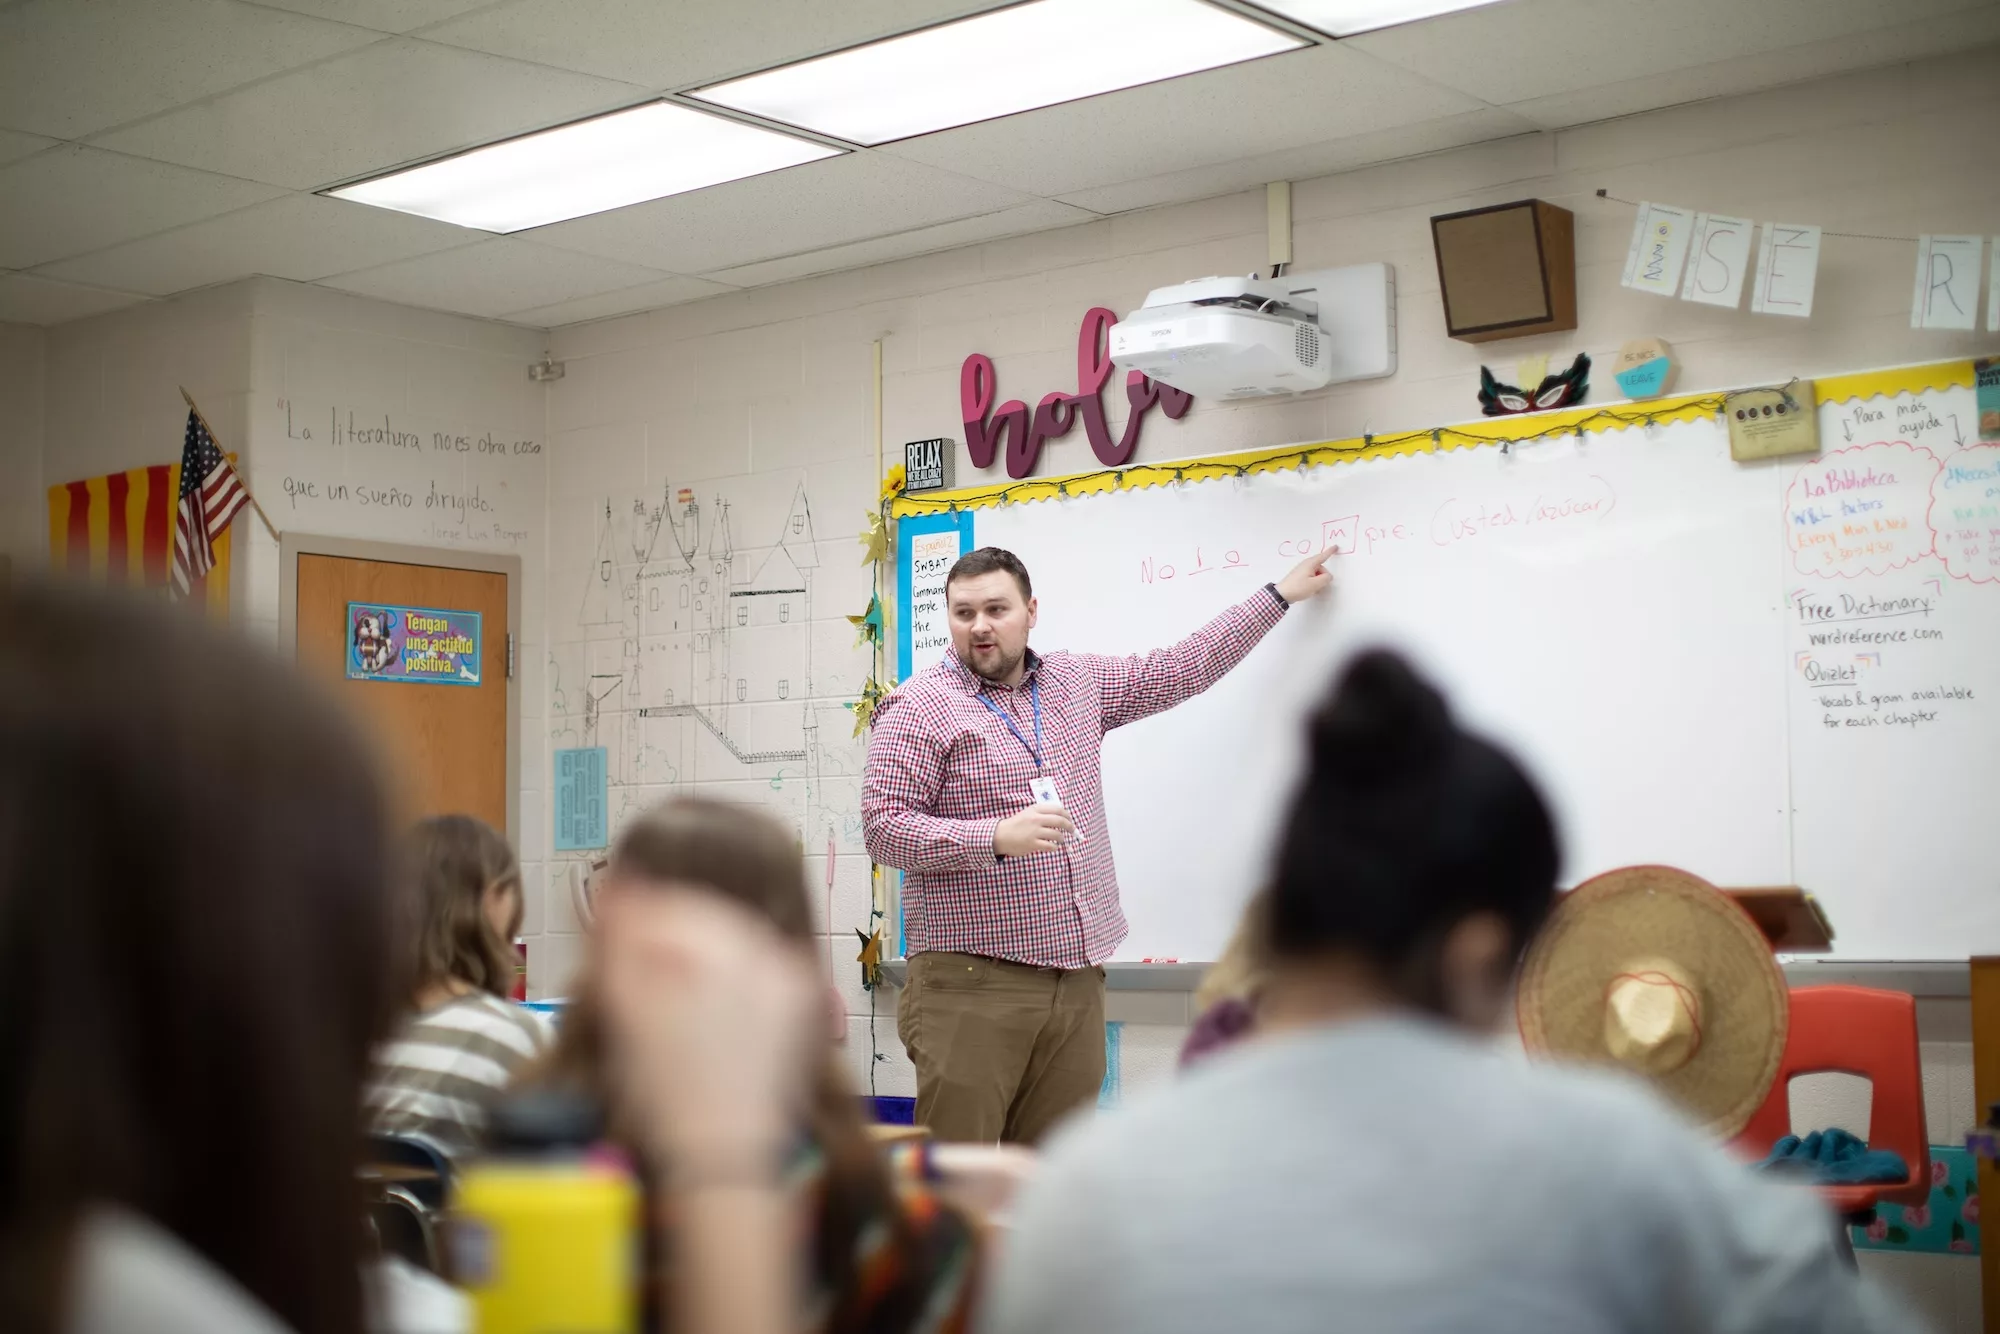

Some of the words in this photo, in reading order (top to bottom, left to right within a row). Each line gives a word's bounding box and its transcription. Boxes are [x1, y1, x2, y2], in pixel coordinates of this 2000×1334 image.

[1625, 372, 1657, 386] LEAVE
[1853, 405, 1884, 425] Para
[1897, 397, 1927, 414] más
[331, 406, 421, 452] literatura
[478, 432, 506, 456] otra
[513, 441, 541, 455] cosa
[1899, 412, 1942, 439] ayuda
[907, 440, 942, 472] RELAX
[283, 477, 319, 510] que
[328, 483, 349, 501] un
[356, 487, 412, 508] sueño
[1841, 498, 1884, 517] tutors
[1141, 556, 1175, 584] No
[913, 580, 947, 598] Command
[913, 600, 939, 618] people
[1797, 593, 1835, 620] Free
[406, 612, 448, 635] Tengan
[912, 620, 931, 633] the
[406, 637, 429, 651] una
[432, 637, 473, 654] actitud
[1808, 628, 1943, 646] wordreference.com
[405, 656, 455, 674] positiva.
[1871, 694, 1903, 712] gram
[1911, 686, 1975, 701] available
[1823, 713, 1840, 729] for
[1846, 716, 1879, 727] each
[1884, 710, 1938, 728] chapter
